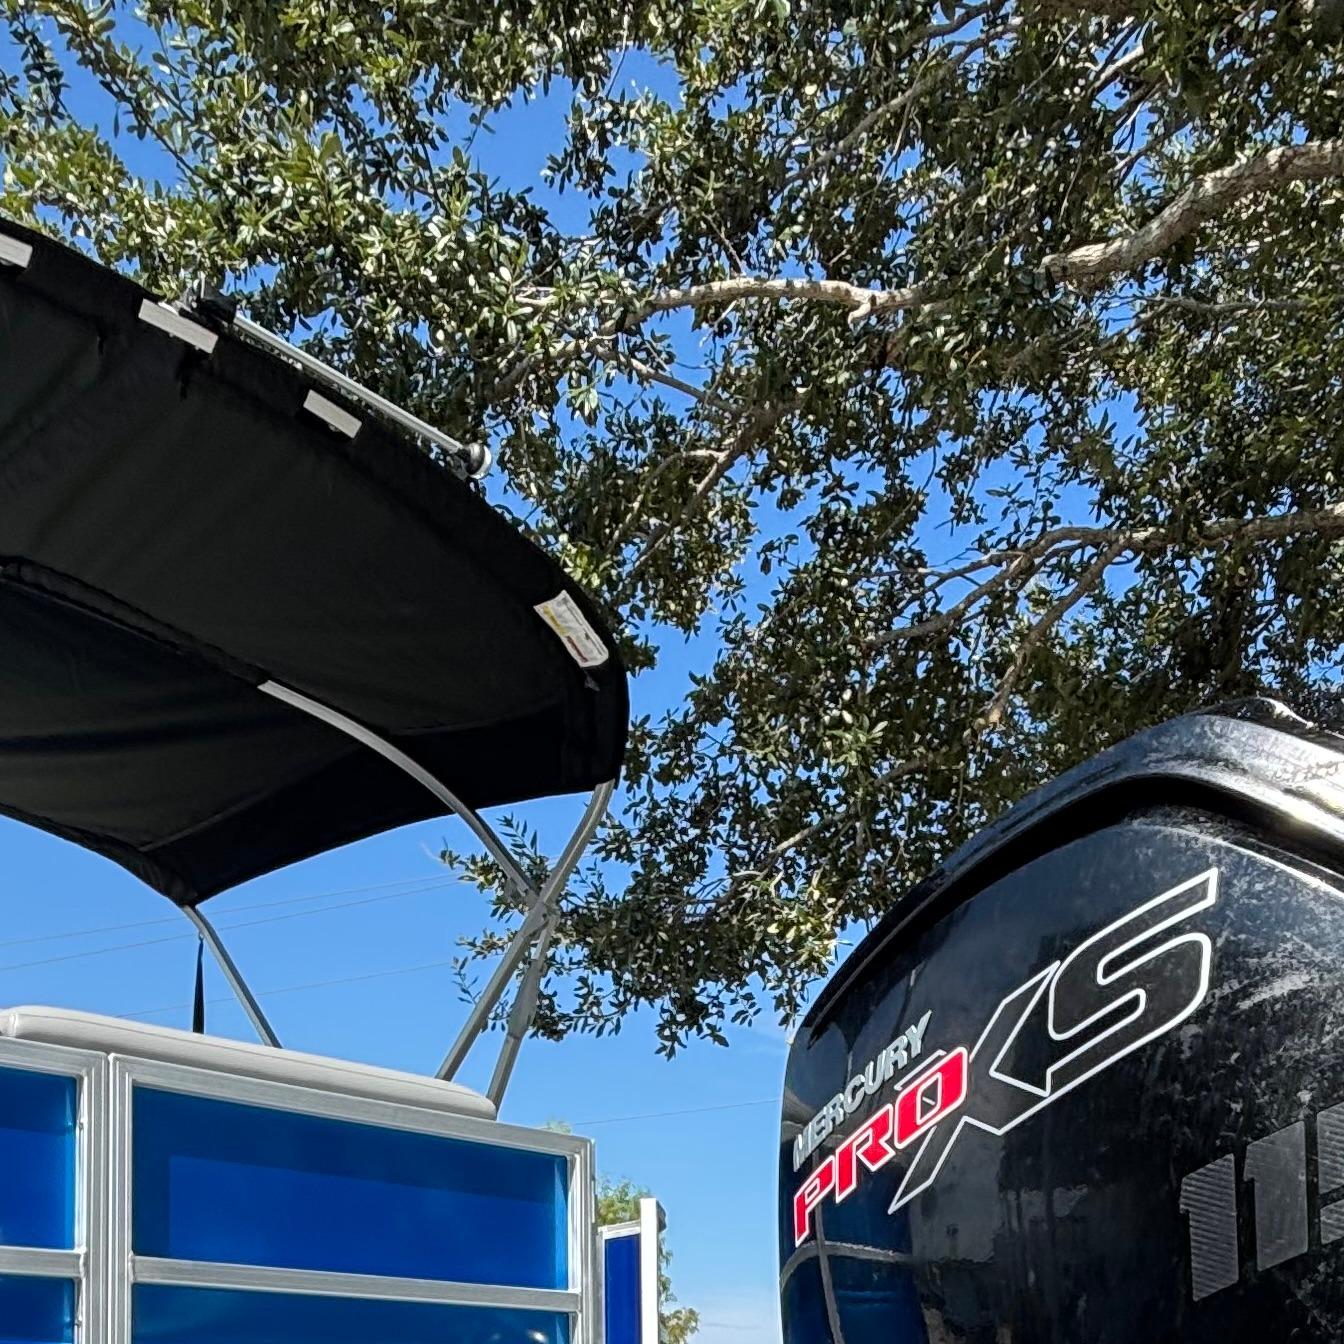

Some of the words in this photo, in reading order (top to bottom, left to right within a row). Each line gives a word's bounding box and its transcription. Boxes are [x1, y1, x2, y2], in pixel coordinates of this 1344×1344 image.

[793, 1009, 933, 1172] MERCURY
[794, 1047, 968, 1247] PRO
[888, 868, 1219, 1214] XS
